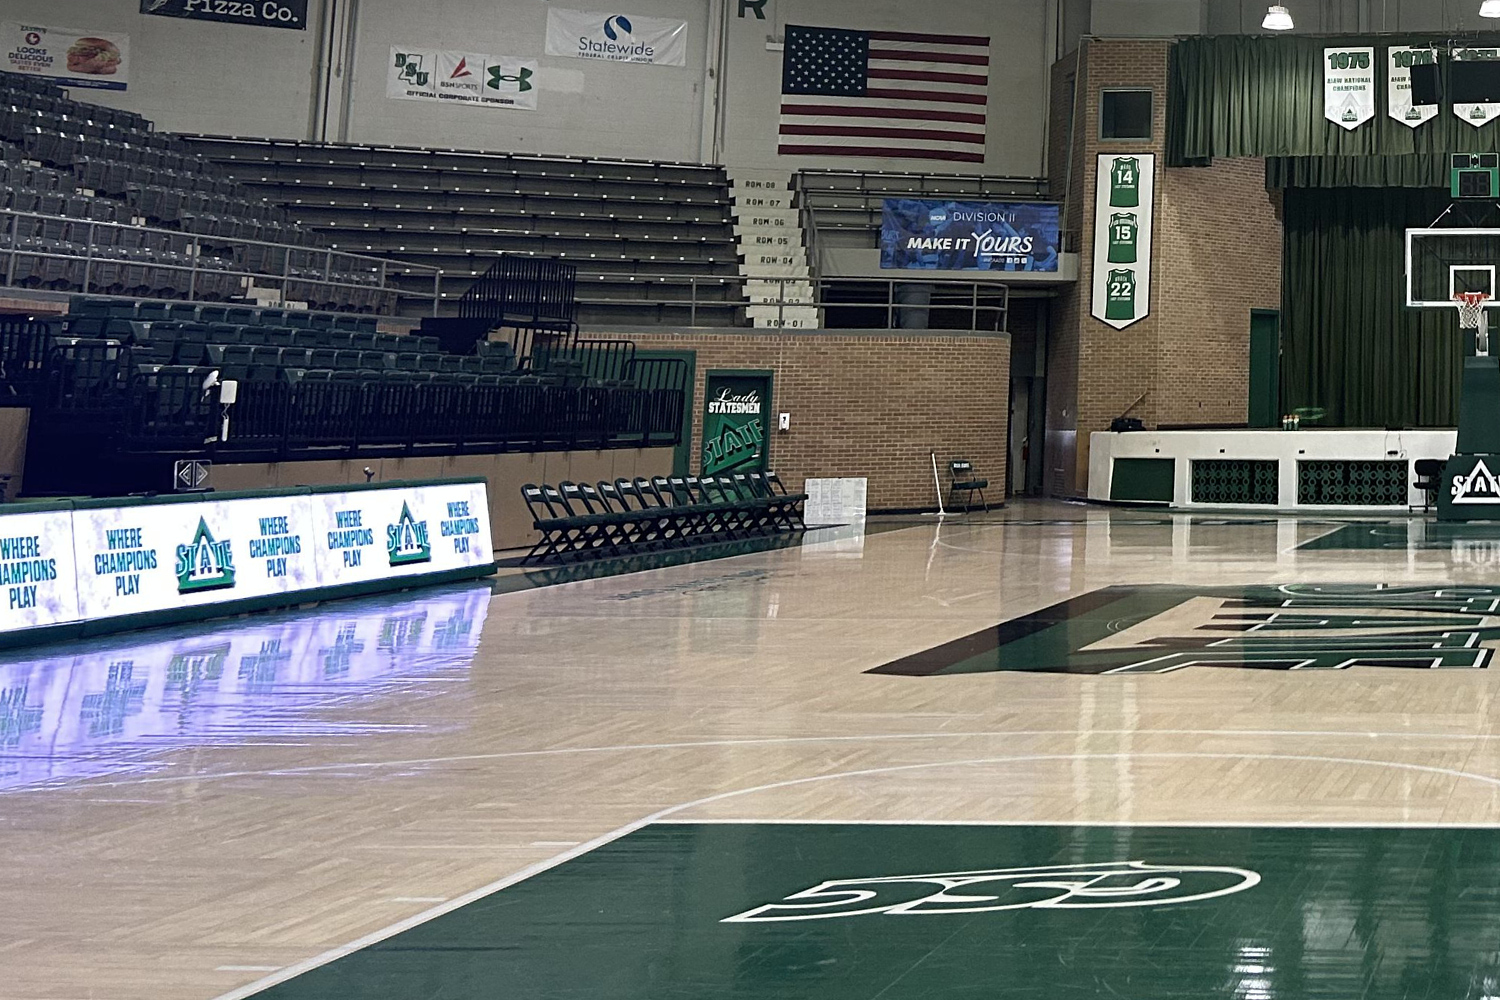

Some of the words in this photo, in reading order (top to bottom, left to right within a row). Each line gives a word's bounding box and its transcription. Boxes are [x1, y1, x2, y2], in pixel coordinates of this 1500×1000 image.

[262, 1, 298, 22] Co.
[17, 47, 47, 55] LOOKS
[578, 37, 654, 56] Statewide
[9, 53, 53, 62] DELICIOUS
[1328, 52, 1370, 69] 1975
[395, 53, 429, 86] DSU
[407, 90, 437, 98] OFFICIAL
[439, 93, 479, 102] CORPORATE
[481, 97, 514, 105] SPONSOR
[1117, 170, 1133, 184] 14
[953, 211, 1006, 222] DIVISION
[1009, 213, 1016, 222] II
[1115, 226, 1131, 240] 15
[907, 237, 952, 250] MAKE
[955, 238, 970, 250] IT
[971, 228, 1033, 257] YOURS
[1111, 282, 1131, 297] 22
[714, 386, 759, 403] Lady
[708, 402, 760, 414] STATESMEN
[447, 501, 469, 517] WHERE
[259, 516, 289, 535] WHERE
[335, 510, 362, 528] WHERE
[441, 518, 479, 536] CHAMPIONS
[106, 528, 142, 550] WHERE
[327, 528, 374, 549] CHAMPIONS
[387, 521, 430, 551] STATE
[0, 536, 40, 559] WHERE
[250, 535, 300, 558] CHAMPIONS
[454, 537, 469, 554] PLAY
[95, 549, 157, 575] CHAMPIONS
[176, 539, 235, 576] STATE
[343, 550, 361, 568] PLAY
[267, 558, 287, 578] PLAY
[116, 574, 140, 596] PLAY
[10, 586, 37, 609] PLAY
